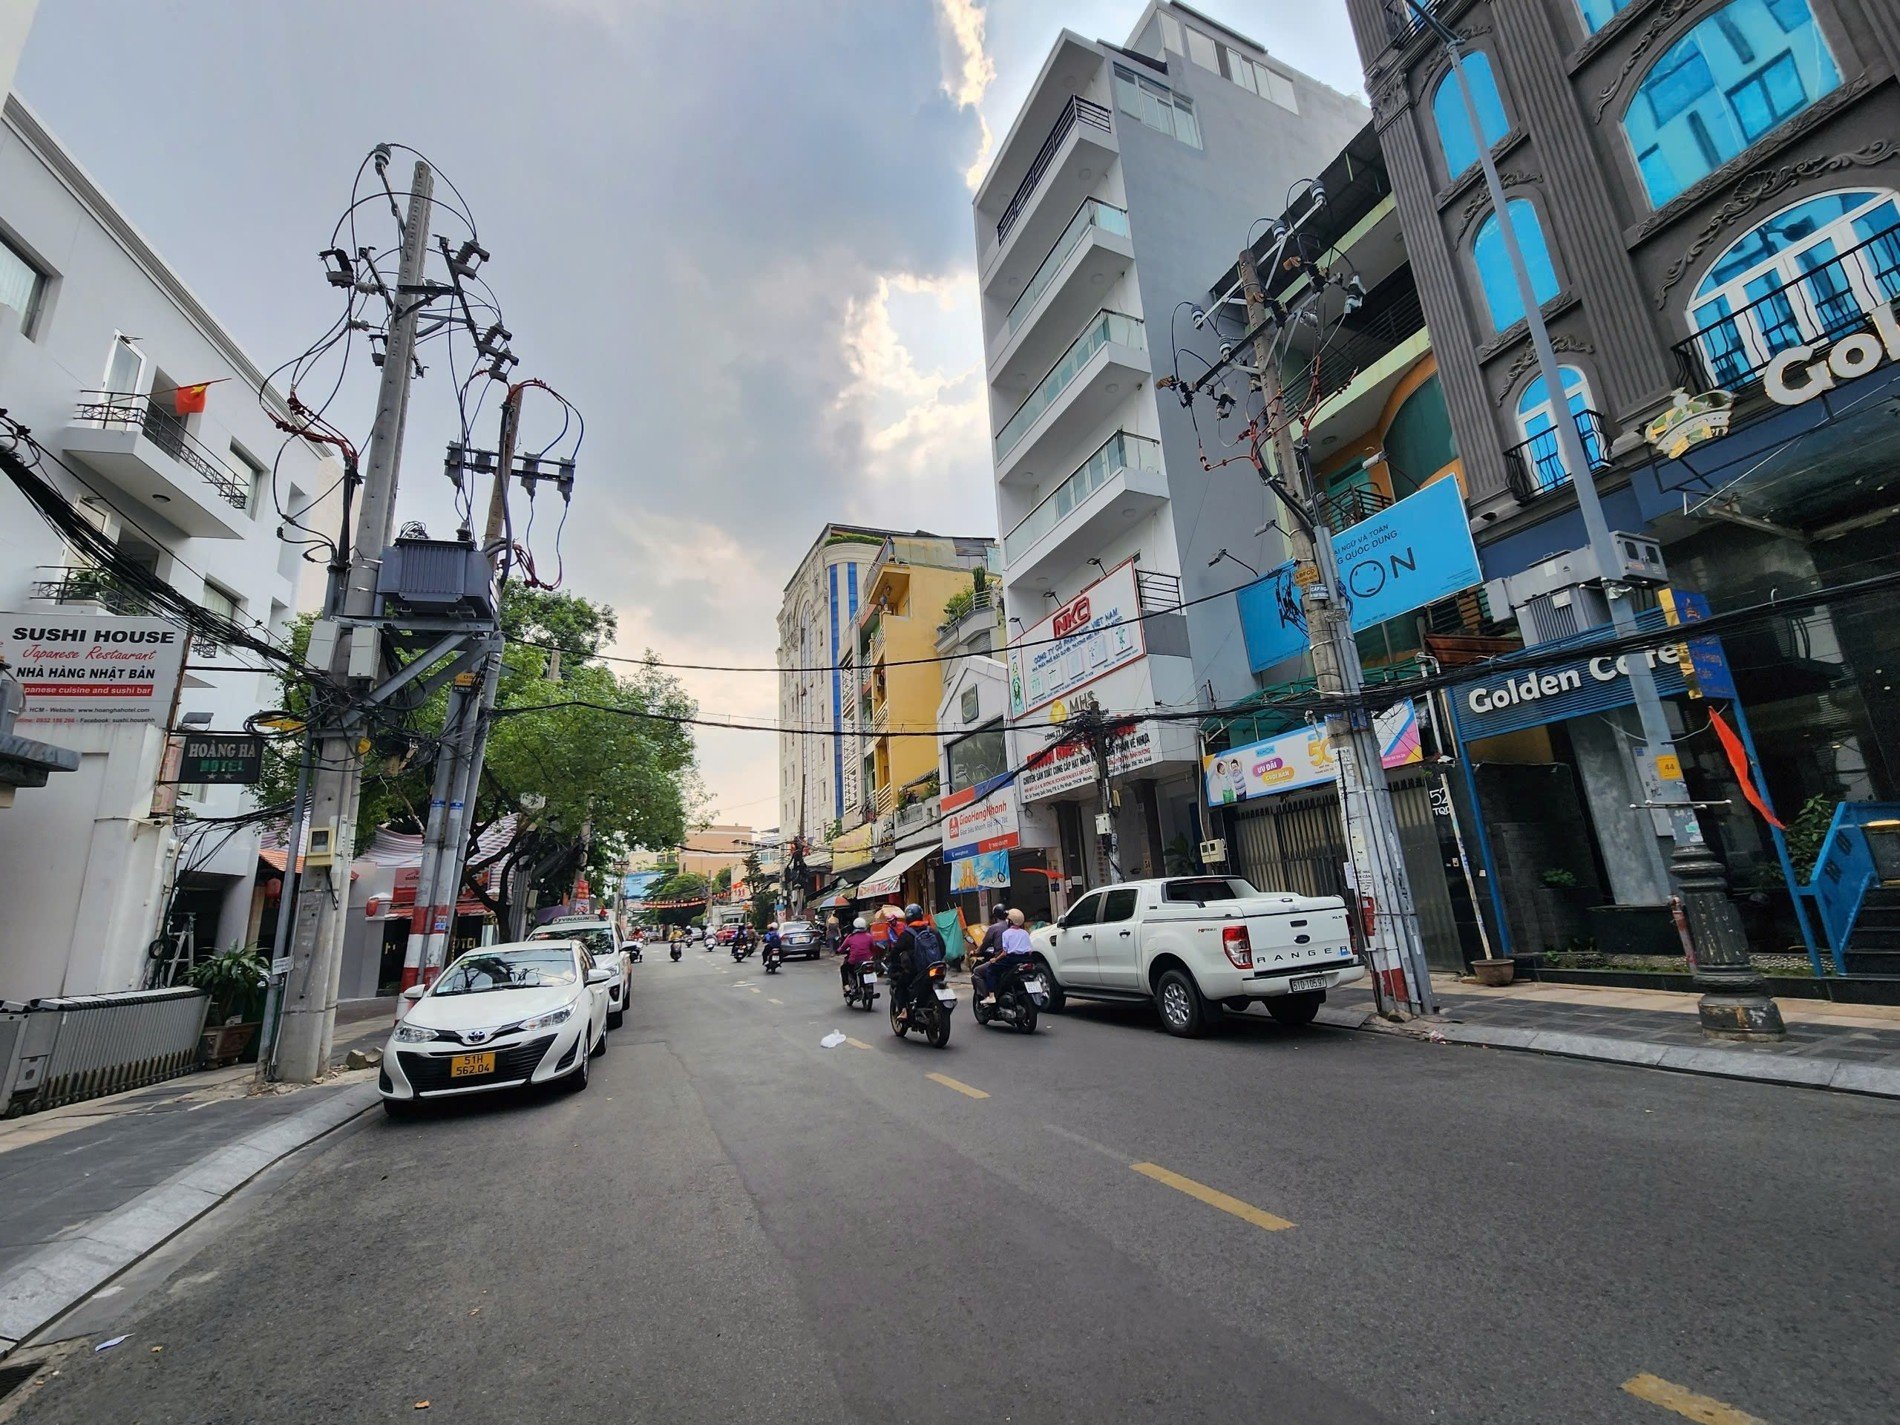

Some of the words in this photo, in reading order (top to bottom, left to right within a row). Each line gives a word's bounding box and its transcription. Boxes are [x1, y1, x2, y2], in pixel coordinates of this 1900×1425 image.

[1763, 302, 1900, 406] Gol
[1054, 598, 1090, 636] NKC
[12, 627, 87, 642] SUSHI
[94, 630, 175, 644] HOUSE
[22, 644, 79, 663] Japanese
[85, 645, 157, 660] Restaurant
[16, 664, 44, 678] NHÀ
[48, 665, 85, 679] HÀNG
[89, 666, 126, 681] NHẬT
[128, 665, 155, 679] BẢN
[24, 687, 57, 696] panese
[58, 686, 90, 695] cuisine
[92, 686, 109, 695] and
[111, 686, 135, 695] sushi
[136, 686, 152, 695] bar
[1468, 669, 1582, 714] Golden
[78, 707, 150, 715] www.hoanghahotel.com
[188, 740, 236, 757] HOÀNG
[238, 741, 256, 757] HÀ
[200, 760, 245, 772] HOTEL
[1257, 945, 1349, 963] RANGER
[464, 1055, 484, 1065] 51H
[456, 1064, 490, 1076] 562.04
